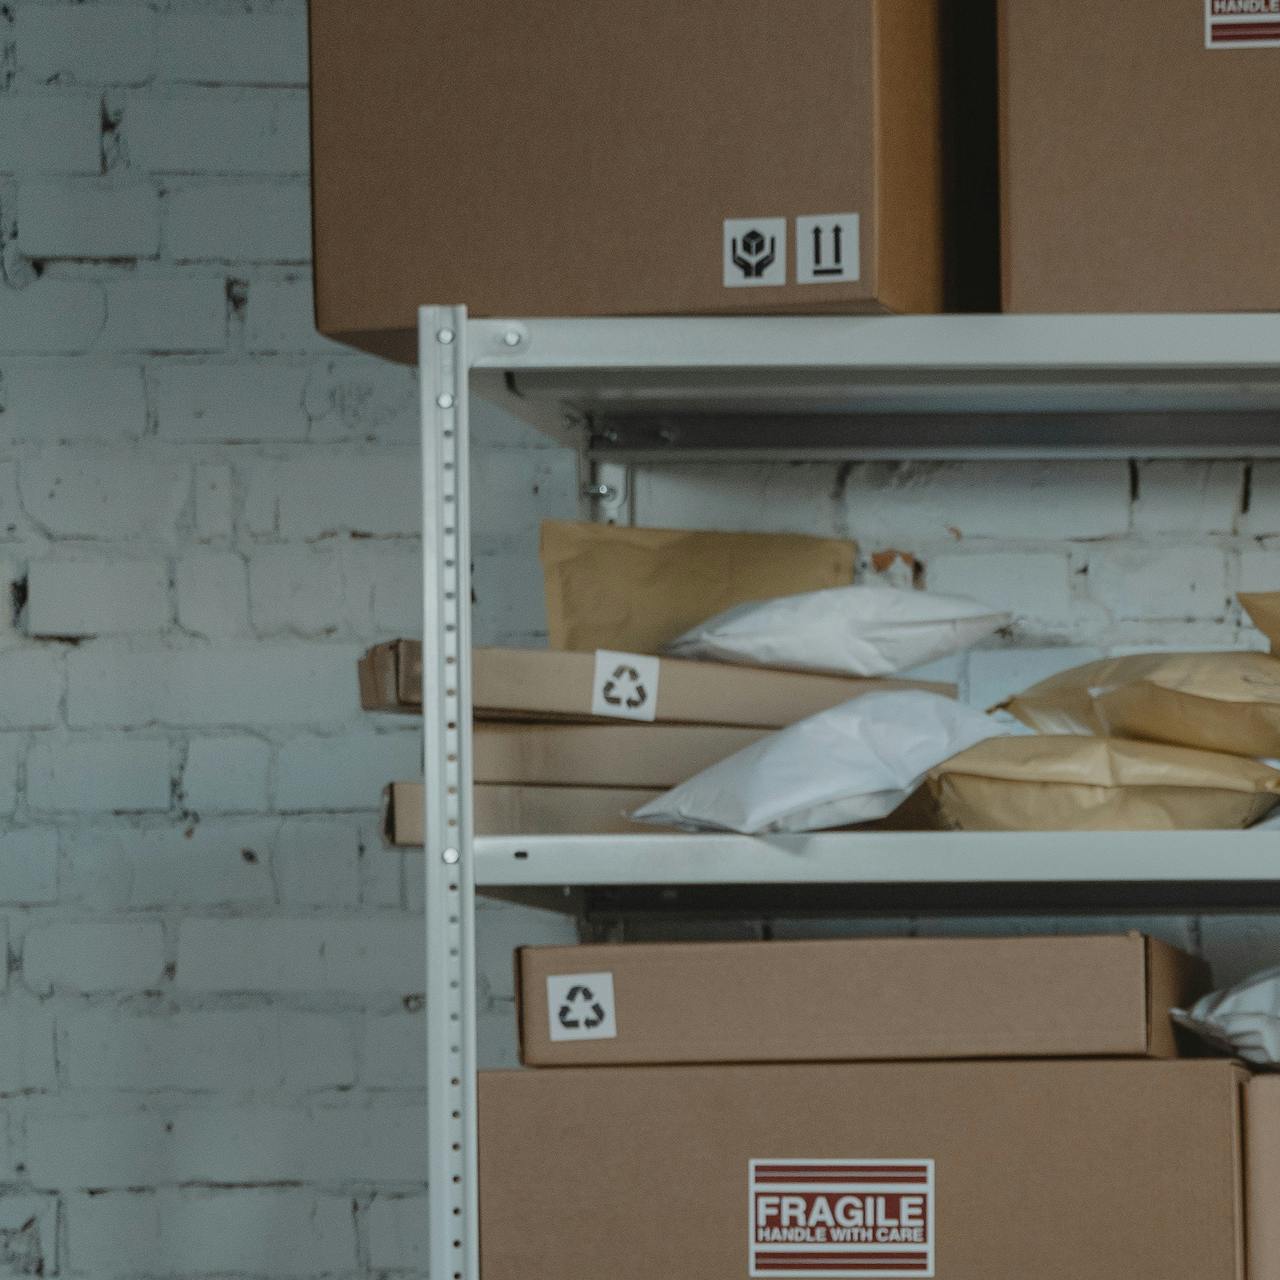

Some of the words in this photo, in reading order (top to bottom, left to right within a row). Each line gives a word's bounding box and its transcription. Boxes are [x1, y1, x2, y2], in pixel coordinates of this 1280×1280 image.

[1214, 0, 1280, 13] HANDLE
[757, 1196, 925, 1228] FRAGILE
[758, 1227, 827, 1243] HANDLE
[830, 1227, 873, 1243] WITH
[876, 1227, 925, 1243] CARE
